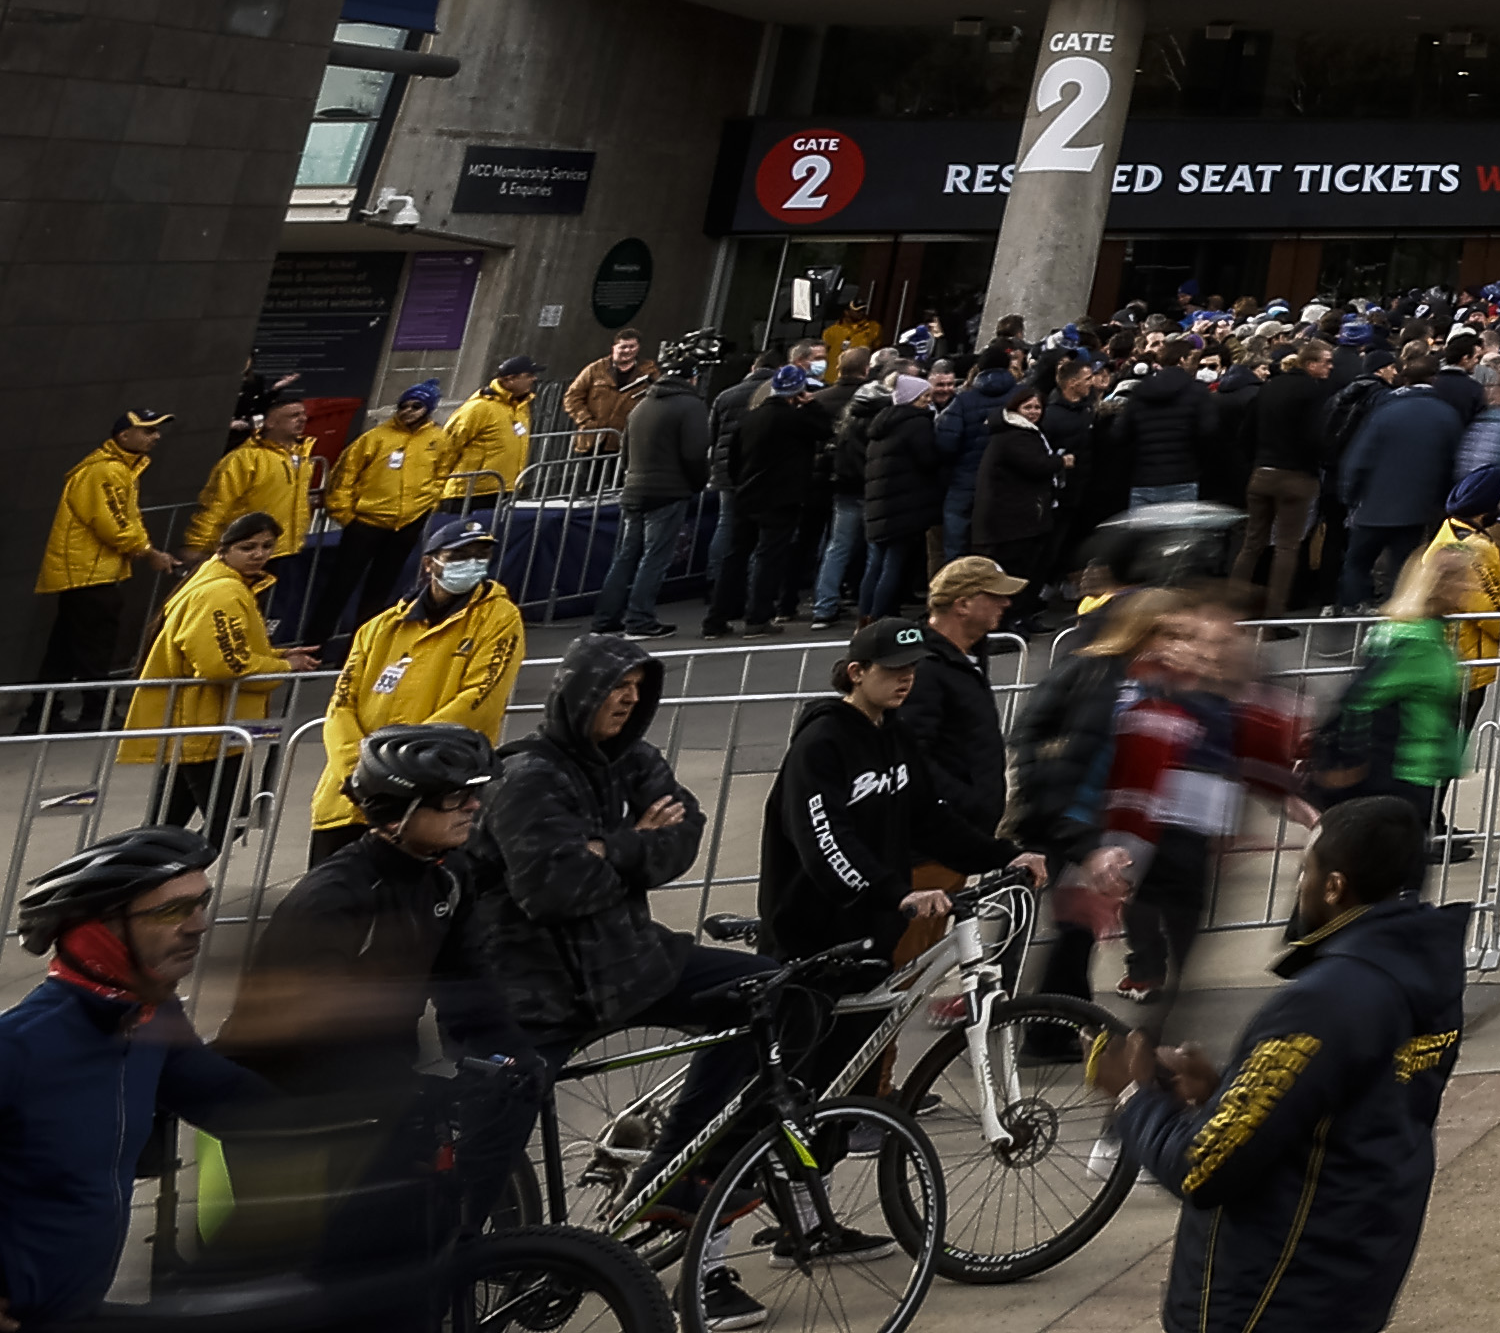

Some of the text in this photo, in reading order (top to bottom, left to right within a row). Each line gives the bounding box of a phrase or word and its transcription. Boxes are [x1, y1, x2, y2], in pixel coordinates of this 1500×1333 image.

[1049, 32, 1115, 53] GATE
[1018, 56, 1112, 173] 2
[793, 137, 840, 153] GATE
[468, 164, 588, 181] MCC Membership Services
[782, 154, 832, 210] 2
[942, 163, 1163, 194] RESED
[1178, 164, 1282, 194] SEAT
[1295, 164, 1461, 193] TICKETS
[499, 184, 552, 198] & Enquiries
[607, 1094, 745, 1232] cannondale
